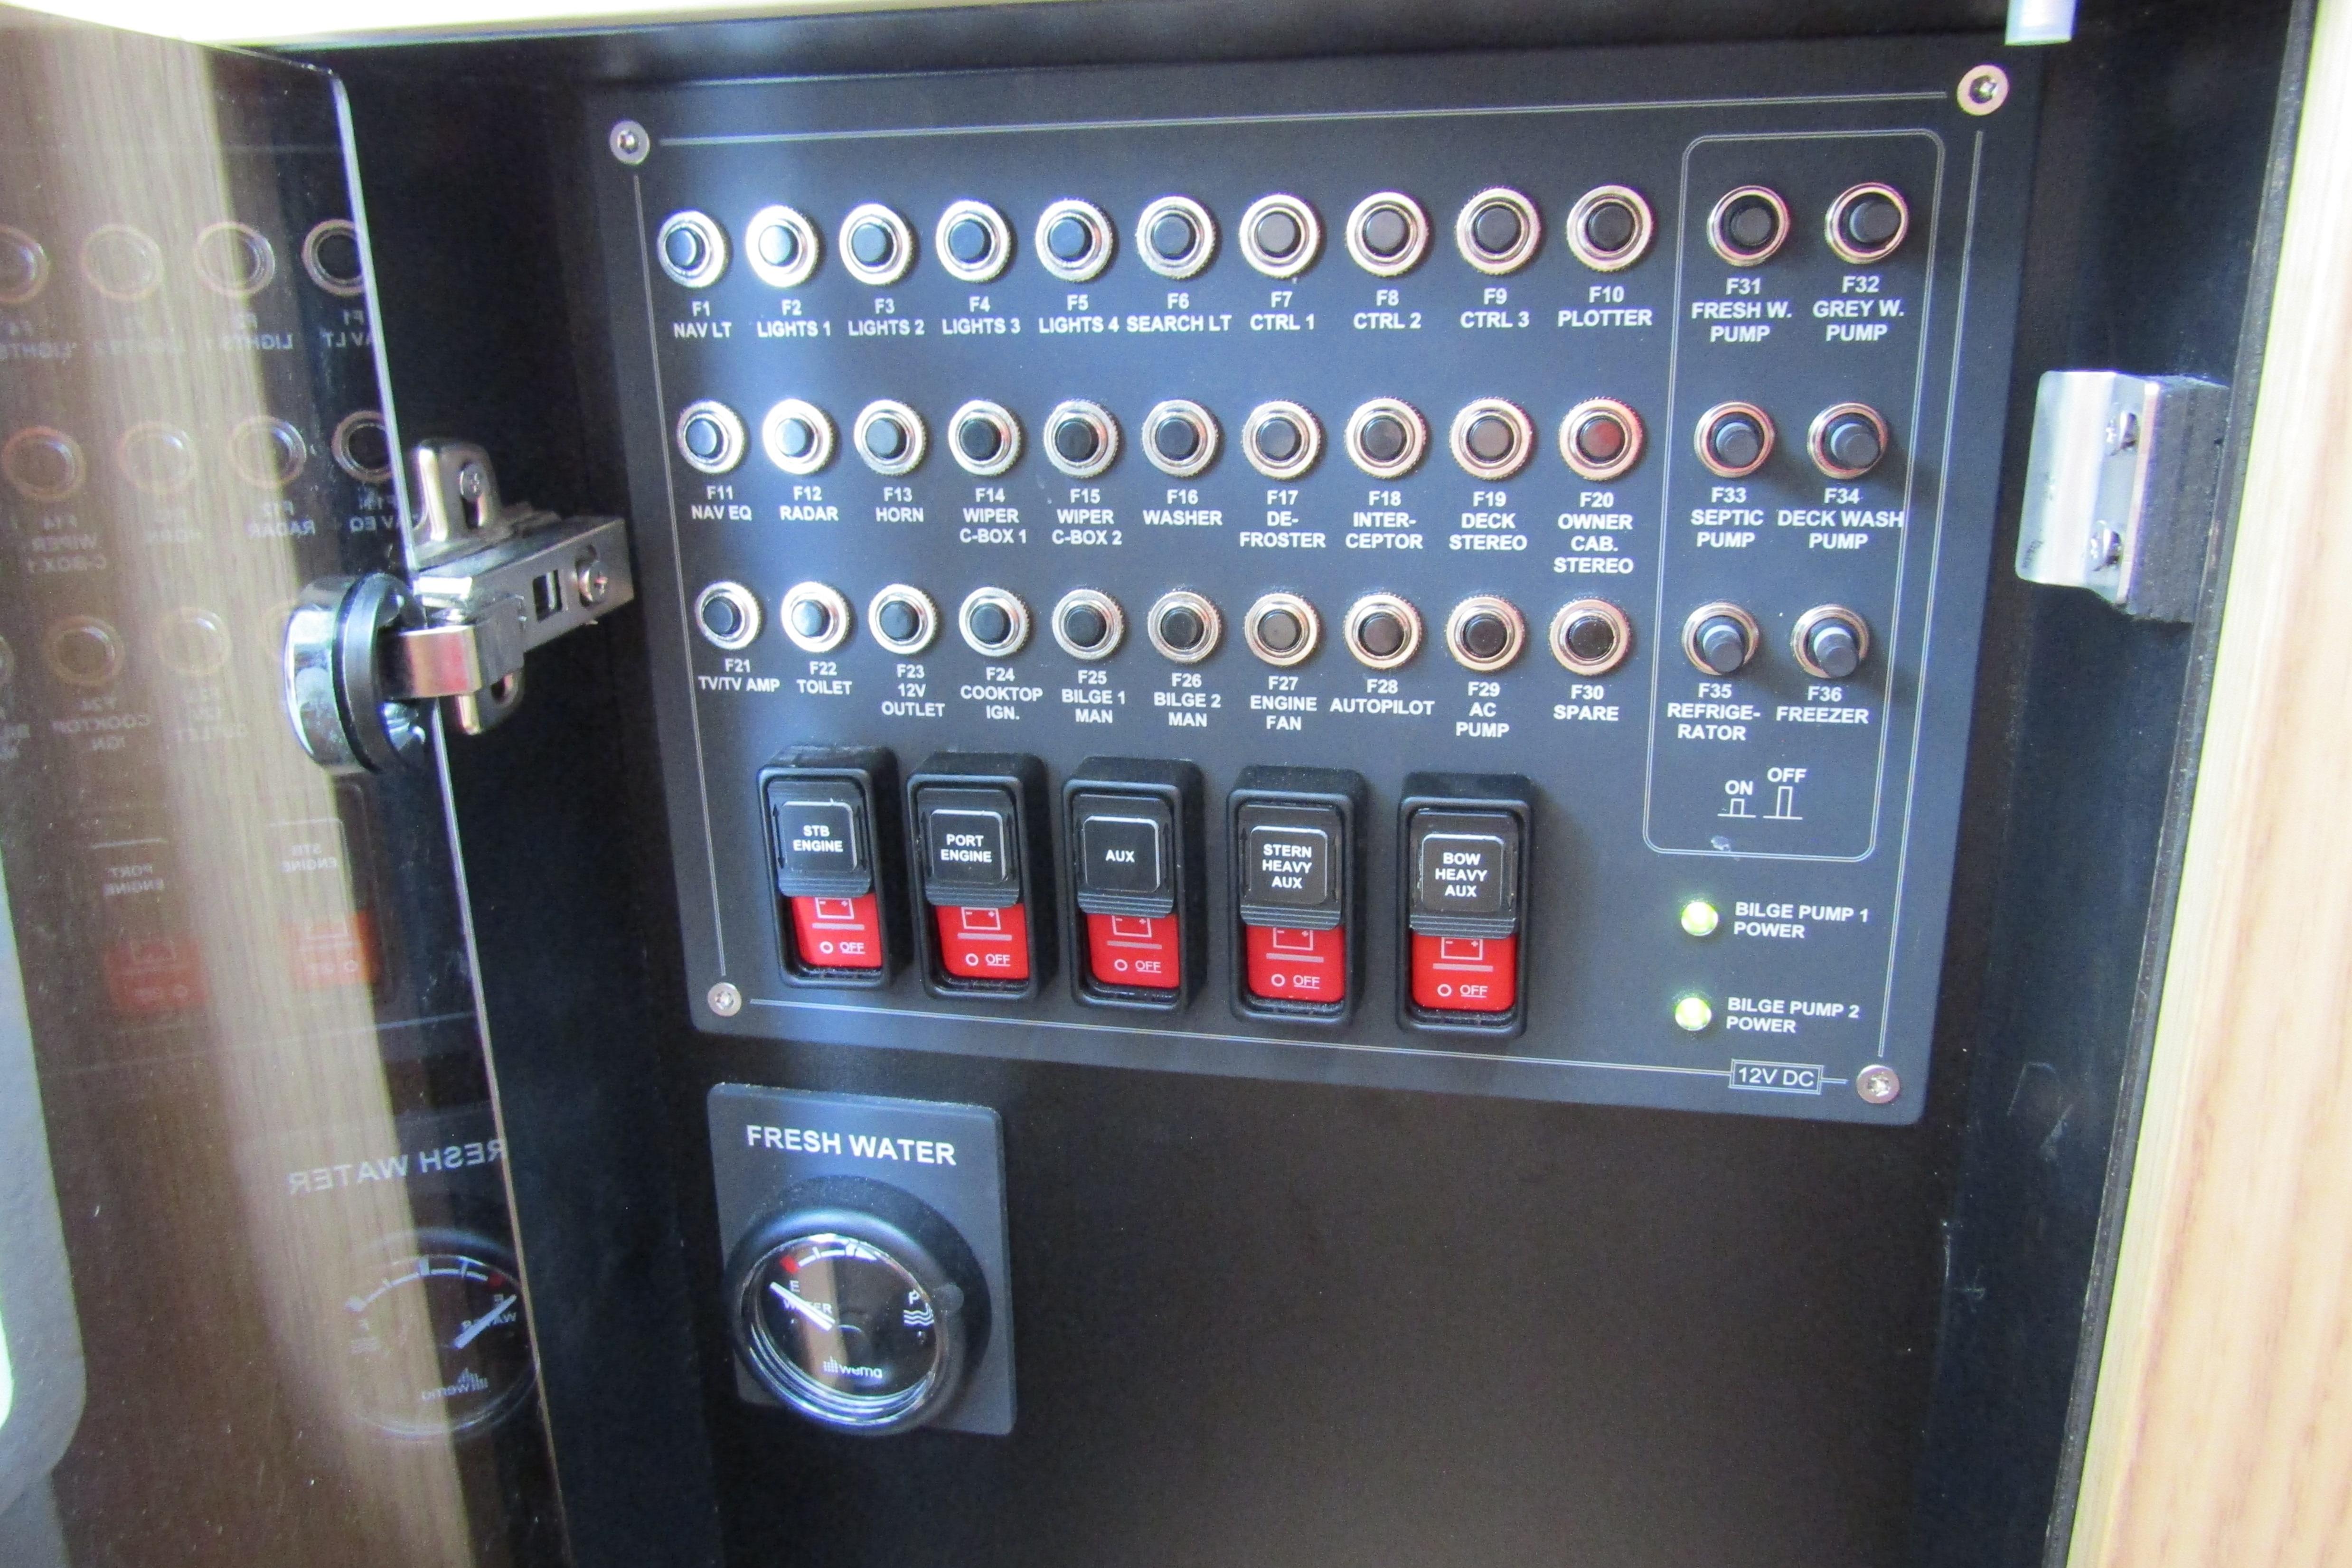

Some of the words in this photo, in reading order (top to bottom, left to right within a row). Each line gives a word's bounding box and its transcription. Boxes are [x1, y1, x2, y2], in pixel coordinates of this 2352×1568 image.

[1726, 278, 1760, 294] F31
[1842, 276, 1879, 293] F32
[1167, 293, 1189, 309] F6
[1271, 291, 1292, 308] F7
[1377, 290, 1399, 306] F8
[1484, 288, 1507, 304] F9
[1590, 286, 1624, 302] F10
[693, 301, 710, 316] F1
[781, 299, 801, 315] F2
[875, 298, 894, 314] F3
[969, 296, 990, 312] F4
[1067, 294, 1088, 310] F5
[1813, 300, 1874, 318] GREY
[1879, 300, 1904, 317] W.
[1692, 302, 1761, 319] FRESH
[1767, 301, 1791, 318] W.
[1039, 316, 1104, 333] LIGHTS
[1108, 317, 1119, 332] 4
[1127, 315, 1204, 332] SEARCH
[1209, 315, 1232, 331] LT
[1250, 314, 1300, 330] CTRL
[1306, 314, 1314, 329] 1
[1354, 313, 1405, 329] CTRL
[1410, 312, 1421, 329] 2
[1460, 311, 1513, 328] CTRL
[1518, 311, 1529, 328] 3
[1558, 309, 1652, 327] PLOTTER
[674, 322, 707, 338] NAV
[712, 321, 732, 338] LT
[757, 320, 818, 338] LIGHTS
[823, 321, 830, 336] 1
[848, 319, 910, 336] LIGHTS
[915, 319, 924, 335] 2
[942, 318, 1006, 334] LIGHTS
[1011, 318, 1020, 334] 3
[1711, 325, 1770, 342] PUMP
[1826, 324, 1887, 341] PUMP
[707, 485, 733, 500] F11
[793, 486, 822, 501] F12
[884, 487, 912, 502] F13
[976, 488, 1005, 502] F14
[1071, 488, 1100, 504] F15
[1167, 489, 1198, 504] F16
[1267, 490, 1298, 505] F17
[1369, 491, 1401, 506] F18
[1473, 491, 1506, 507] F19
[1580, 492, 1614, 507] F20
[1712, 487, 1746, 503] F33
[1825, 488, 1860, 504] F34
[692, 505, 724, 519] NAV
[729, 505, 752, 521] EQ
[780, 506, 838, 521] RADAR
[876, 507, 923, 522] HORN
[963, 508, 1019, 523] WIPER
[1057, 509, 1114, 524] WIPER
[1143, 510, 1223, 525] WASHER
[1267, 511, 1298, 526] DE-
[1354, 512, 1416, 527] INTER-
[1462, 513, 1515, 528] DECK
[1691, 509, 1763, 526] SEPTIC
[1778, 510, 1836, 526] DECK
[1841, 511, 1904, 527] WASH
[1558, 514, 1632, 529] OWNER
[960, 528, 1014, 543] C-BOX
[1019, 529, 1026, 543] 1
[1052, 529, 1108, 545] C-BOX
[1112, 530, 1122, 545] 2
[1240, 532, 1326, 547] FROSTER
[1345, 533, 1423, 549] CEPTOR
[1449, 535, 1527, 550] STEREO
[1571, 535, 1618, 551] CAB.
[1697, 532, 1755, 547] PUMP
[1809, 533, 1868, 549] PUMP
[1554, 557, 1633, 573] STEREO
[725, 658, 750, 673] F21
[809, 661, 837, 676] F22
[897, 664, 924, 678] F23
[986, 667, 1015, 681] F24
[1078, 670, 1107, 685] F25
[1172, 673, 1202, 687] F26
[698, 676, 742, 691] TV/TV
[747, 678, 780, 692] AMP
[796, 679, 852, 695] TOILET
[898, 683, 926, 697] 12V
[1269, 676, 1298, 690] F27
[1367, 679, 1398, 694] F28
[1468, 682, 1500, 697] F29
[1698, 683, 1731, 698] F35
[960, 685, 1043, 701] COOKTOP
[1062, 689, 1112, 704] BILGE
[1118, 691, 1125, 704] 1
[1154, 692, 1206, 707] BILGE
[1211, 694, 1221, 708] 2
[1571, 685, 1604, 700] F30
[1808, 686, 1842, 702] F36
[882, 701, 945, 717] OUTLET
[1251, 695, 1317, 711] ENGINE
[1330, 698, 1435, 715] AUTOPILOT
[1469, 702, 1496, 717] AC
[986, 705, 1019, 720] IGN.
[1075, 708, 1112, 723] MAN
[1553, 704, 1619, 721] SPARE
[1667, 703, 1760, 720] REFRIGE-
[1776, 706, 1869, 723] FREEZER
[1169, 712, 1207, 727] MAN
[1267, 715, 1301, 730] FAN
[1456, 722, 1509, 737] PUMP
[1678, 724, 1746, 741] RATOR
[1768, 768, 1806, 783] OFF
[1725, 780, 1753, 795] ON
[803, 825, 829, 836] STB
[793, 839, 843, 852] ENGINE
[947, 834, 984, 847] PORT
[941, 849, 992, 863] ENGINE
[1106, 850, 1135, 862] AUX
[1264, 844, 1311, 858] STERN
[1443, 852, 1480, 865] BOW
[1262, 859, 1312, 873] HEAVY
[1435, 868, 1487, 881] HEAVY
[1272, 876, 1302, 889] AUX
[1445, 885, 1477, 897] AUX
[1735, 902, 1793, 919] BILGE
[1799, 905, 1854, 921] PUMP
[1860, 909, 1868, 922] 1
[1734, 921, 1805, 938] POWER
[839, 942, 865, 954] OFF
[985, 954, 1010, 967] OFF
[1135, 960, 1161, 973] OFF
[1293, 975, 1320, 989] OFF
[1460, 985, 1488, 998] OFF
[1728, 997, 1784, 1014] BILGE
[1790, 1001, 1844, 1016] PUMP
[1848, 1005, 1859, 1018] 2
[1726, 1016, 1796, 1033] POWER
[1739, 1067, 1778, 1084] 12V
[1783, 1070, 1814, 1087] DC
[747, 1126, 841, 1155] FRESH
[848, 1135, 956, 1165] WATER
[790, 1280, 800, 1292] E
